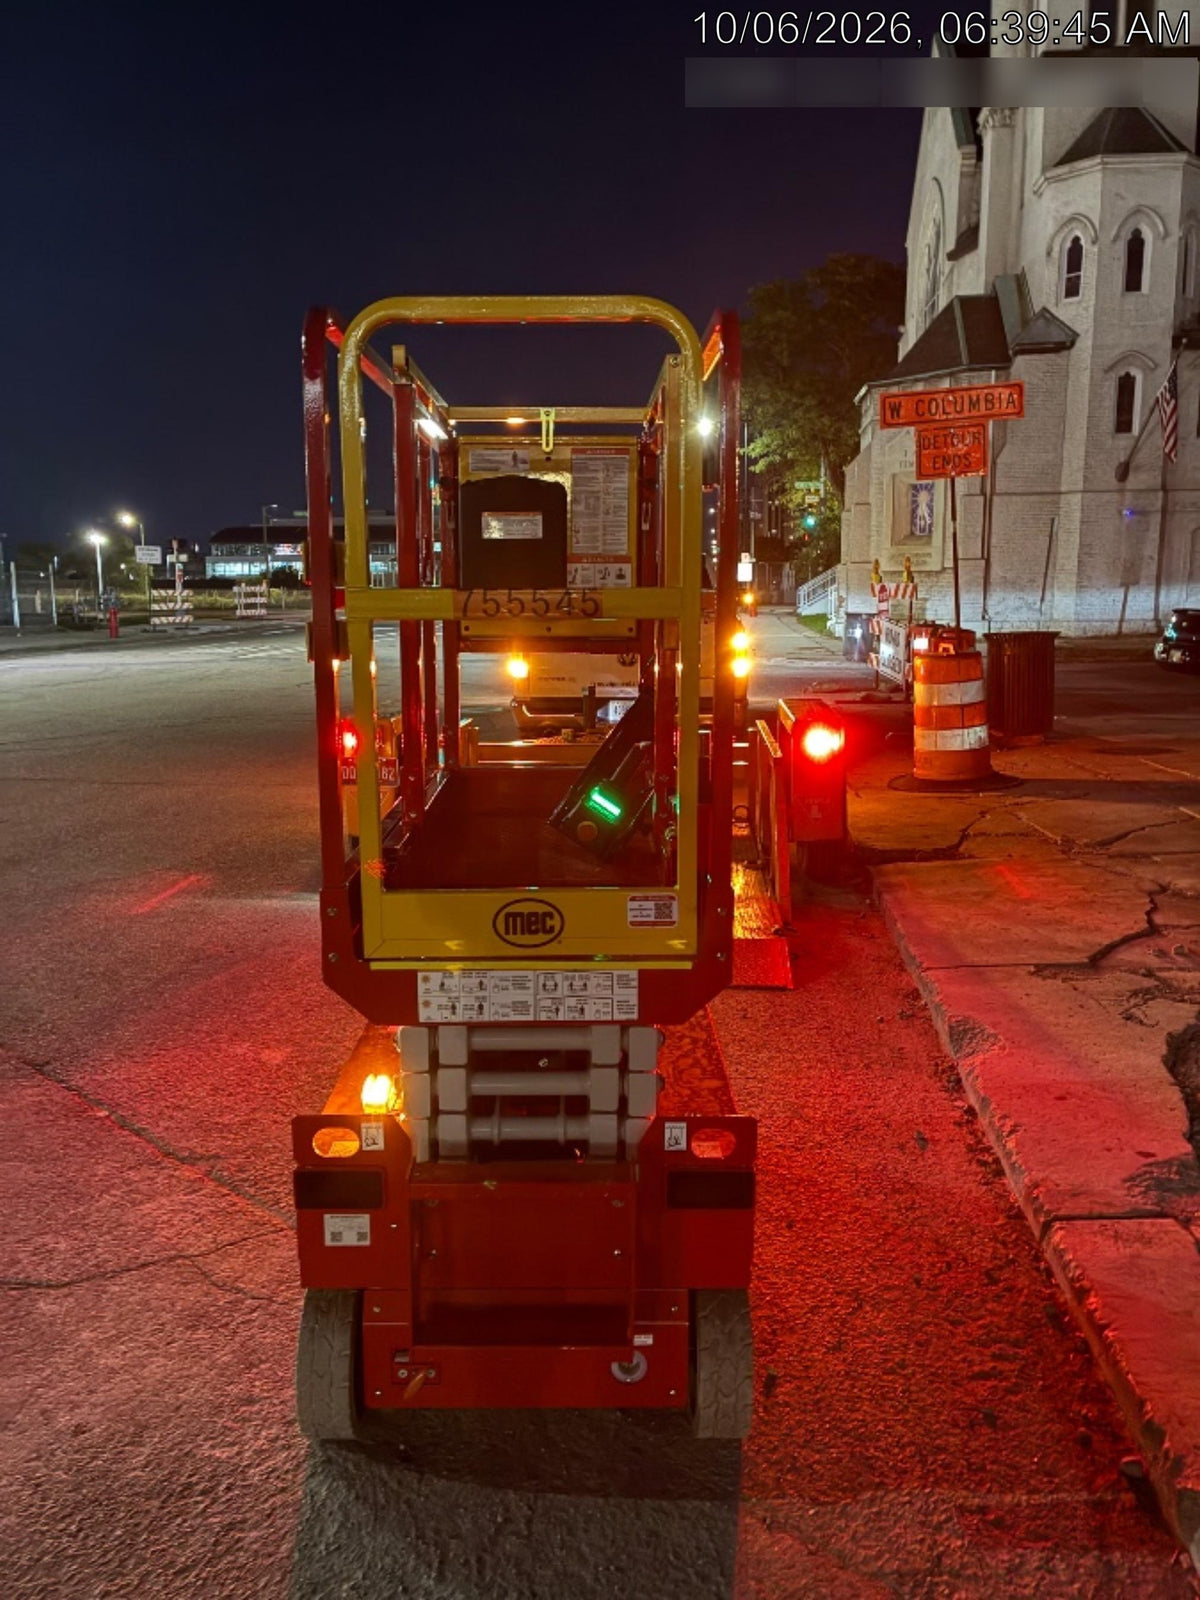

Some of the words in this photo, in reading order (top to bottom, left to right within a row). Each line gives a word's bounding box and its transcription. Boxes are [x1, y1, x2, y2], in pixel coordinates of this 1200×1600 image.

[888, 401, 902, 420] W
[914, 391, 1017, 417] COLUMBIA
[922, 431, 982, 451] DETOUR
[931, 453, 973, 471] ENDS
[461, 588, 600, 618] 755545
